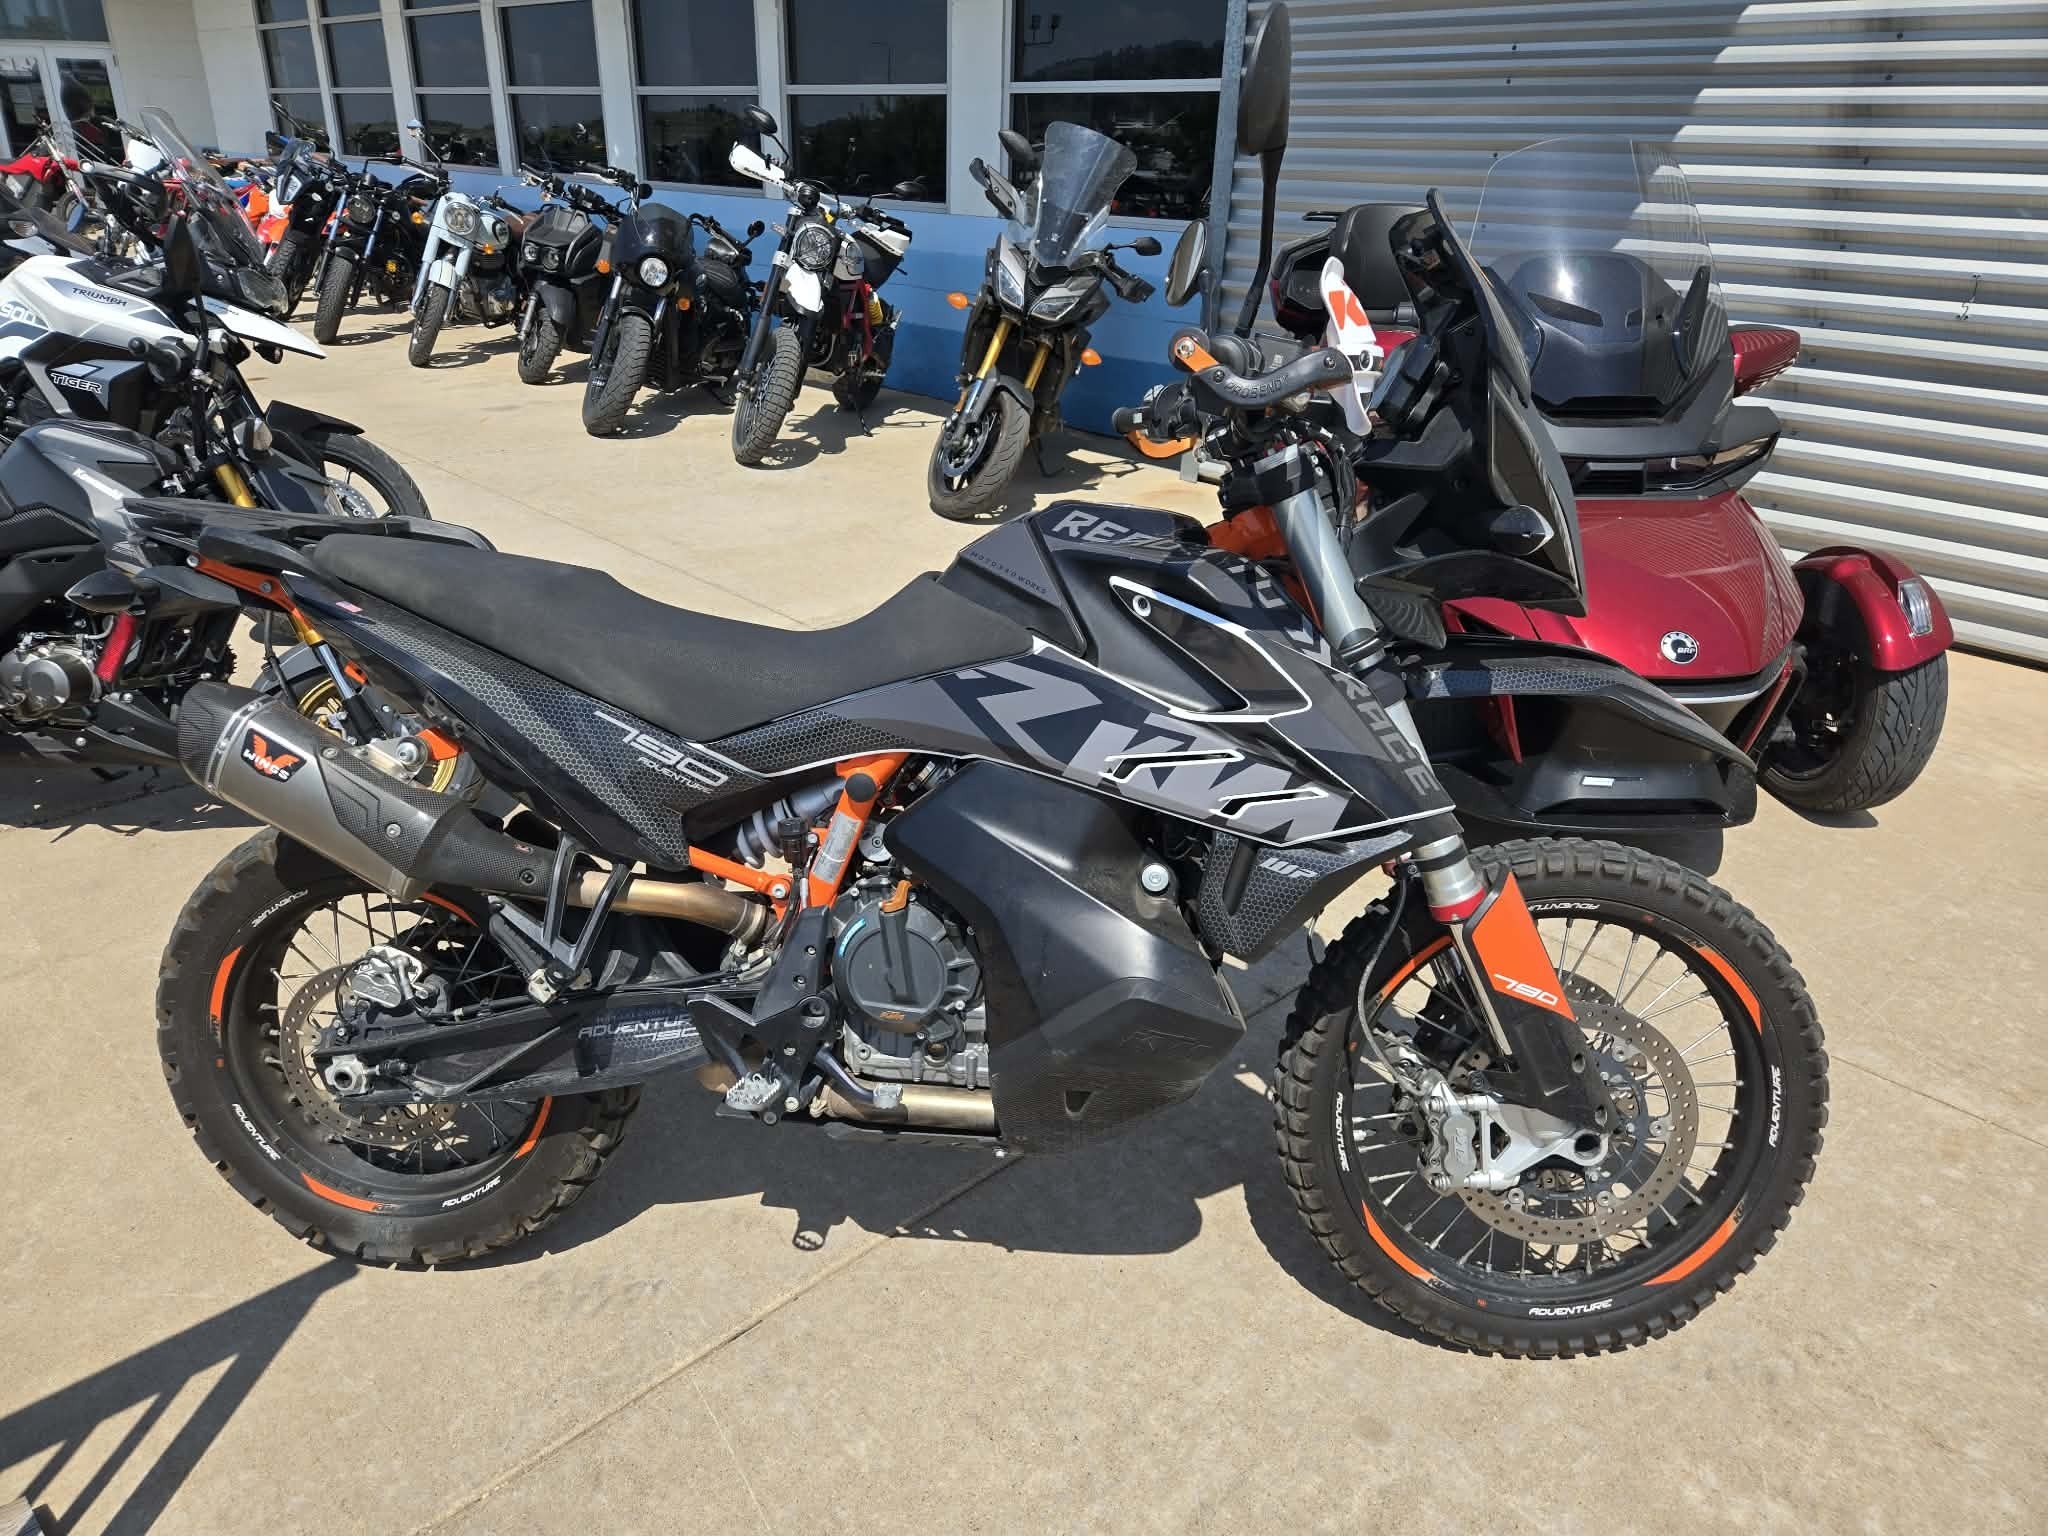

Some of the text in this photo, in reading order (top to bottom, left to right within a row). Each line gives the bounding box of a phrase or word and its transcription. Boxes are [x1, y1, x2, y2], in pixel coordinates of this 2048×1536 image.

[72, 286, 127, 307] TRIUMPH
[51, 372, 102, 394] TIGER
[593, 710, 729, 787] 790
[1331, 671, 1441, 797] RACE
[242, 748, 291, 780] WINGS
[637, 755, 714, 795] ADVENTURE
[1528, 902, 1601, 912] ADVENTU
[1493, 973, 1559, 1006] 790
[577, 1014, 692, 1040] ADVENTUR
[1768, 1064, 1782, 1149] ADVENTURE
[232, 1103, 282, 1162] ADVENTURE
[1335, 1091, 1351, 1173] ADVENTURE
[441, 1175, 501, 1209] ADVENTURE
[1528, 1298, 1614, 1317] ADVENTURE
